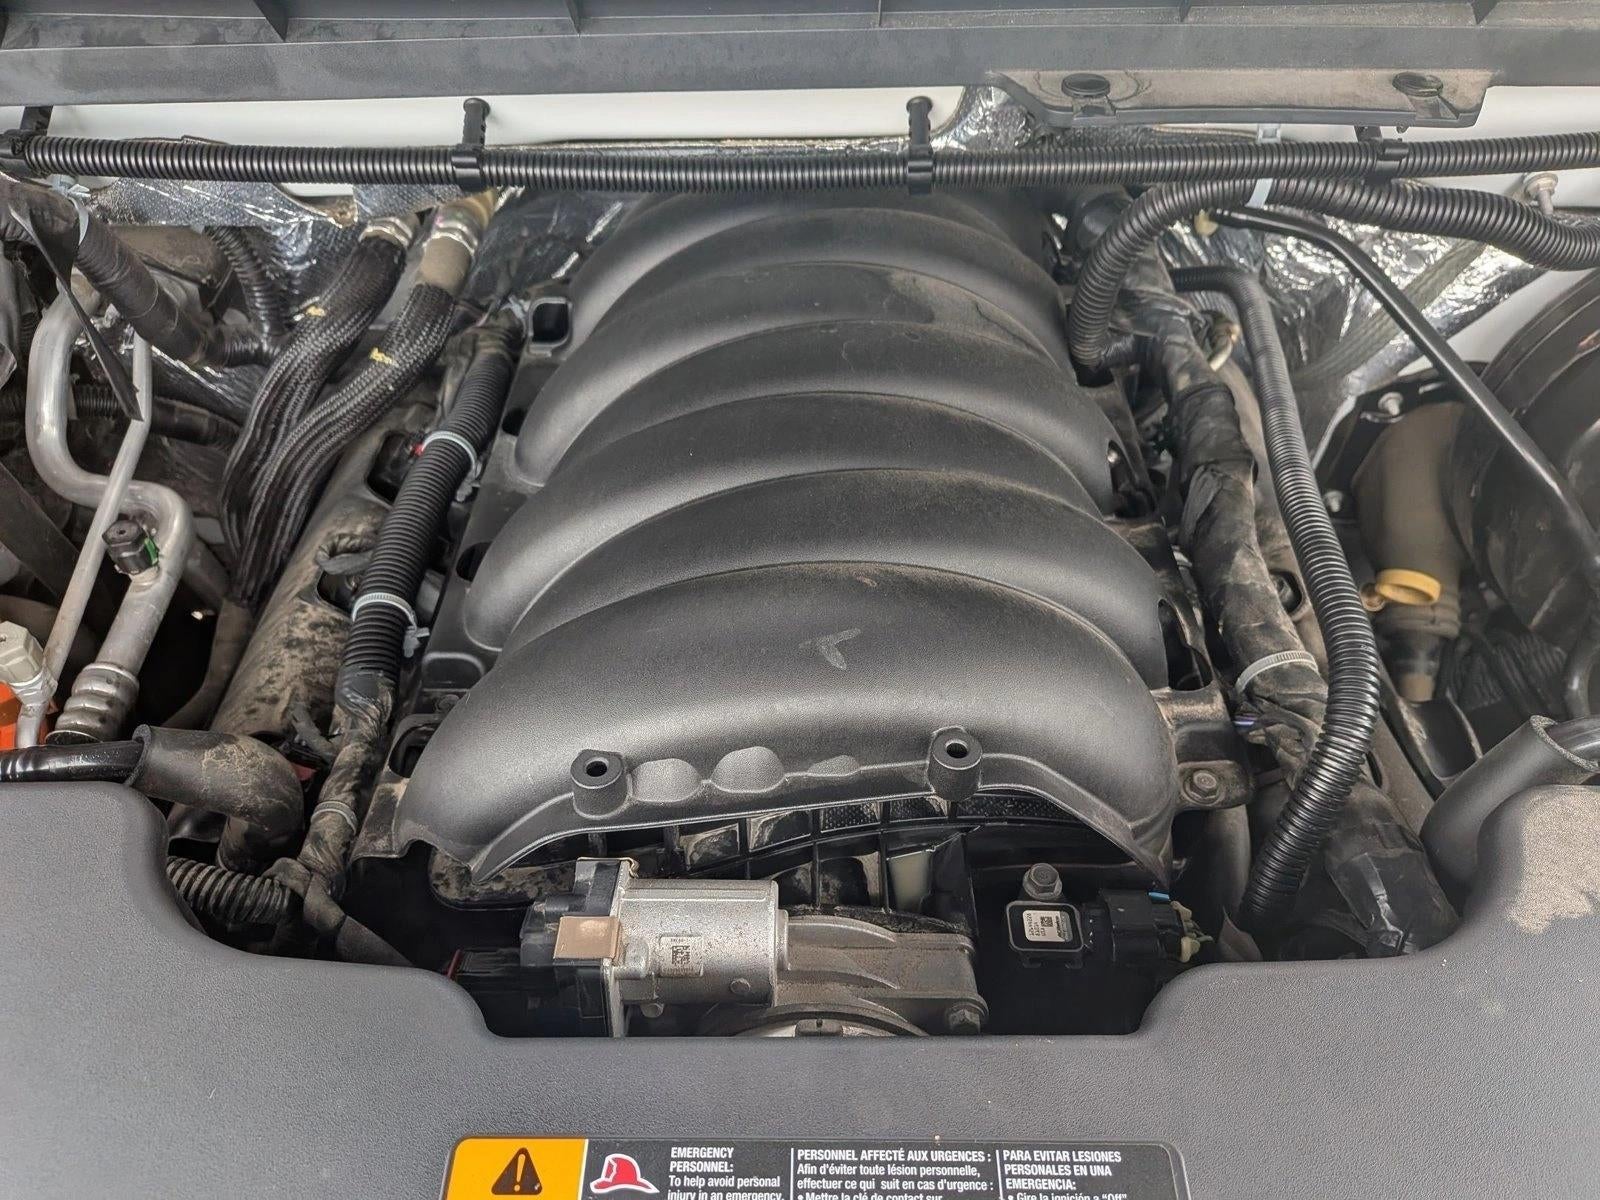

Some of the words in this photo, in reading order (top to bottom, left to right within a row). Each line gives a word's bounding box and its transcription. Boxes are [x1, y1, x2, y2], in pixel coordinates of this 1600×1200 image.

[670, 1147, 734, 1158] EMERGENCY
[797, 1149, 858, 1160] PERSONNEL
[860, 1148, 906, 1161] AFFECTÉ
[908, 1150, 928, 1162] AUX
[1003, 1150, 1032, 1161] PARA
[1034, 1150, 1070, 1162] EVITAR
[1072, 1151, 1122, 1162] LESIONES
[670, 1161, 734, 1172] PERSONNEL:
[797, 1163, 817, 1174] Afin
[820, 1163, 857, 1175] d'éviter
[860, 1164, 886, 1176] toute
[888, 1164, 917, 1176] lésion
[920, 1165, 980, 1178] personnelle,
[1004, 1164, 1072, 1176] PERSONALES
[1074, 1165, 1088, 1176] EN
[1090, 1165, 1112, 1176] UNA
[668, 1175, 681, 1186] To
[684, 1176, 705, 1188] help
[708, 1176, 734, 1187] avoid
[737, 1176, 780, 1189] personal
[797, 1178, 842, 1190] effectuer
[844, 1180, 858, 1190] ce
[860, 1178, 875, 1192] qui
[880, 1178, 900, 1190] suit
[902, 1180, 914, 1190] en
[917, 1180, 935, 1190] cas
[1006, 1178, 1076, 1190] EMERGENCIA:
[698, 1190, 708, 1200] in
[710, 1192, 723, 1200] an
